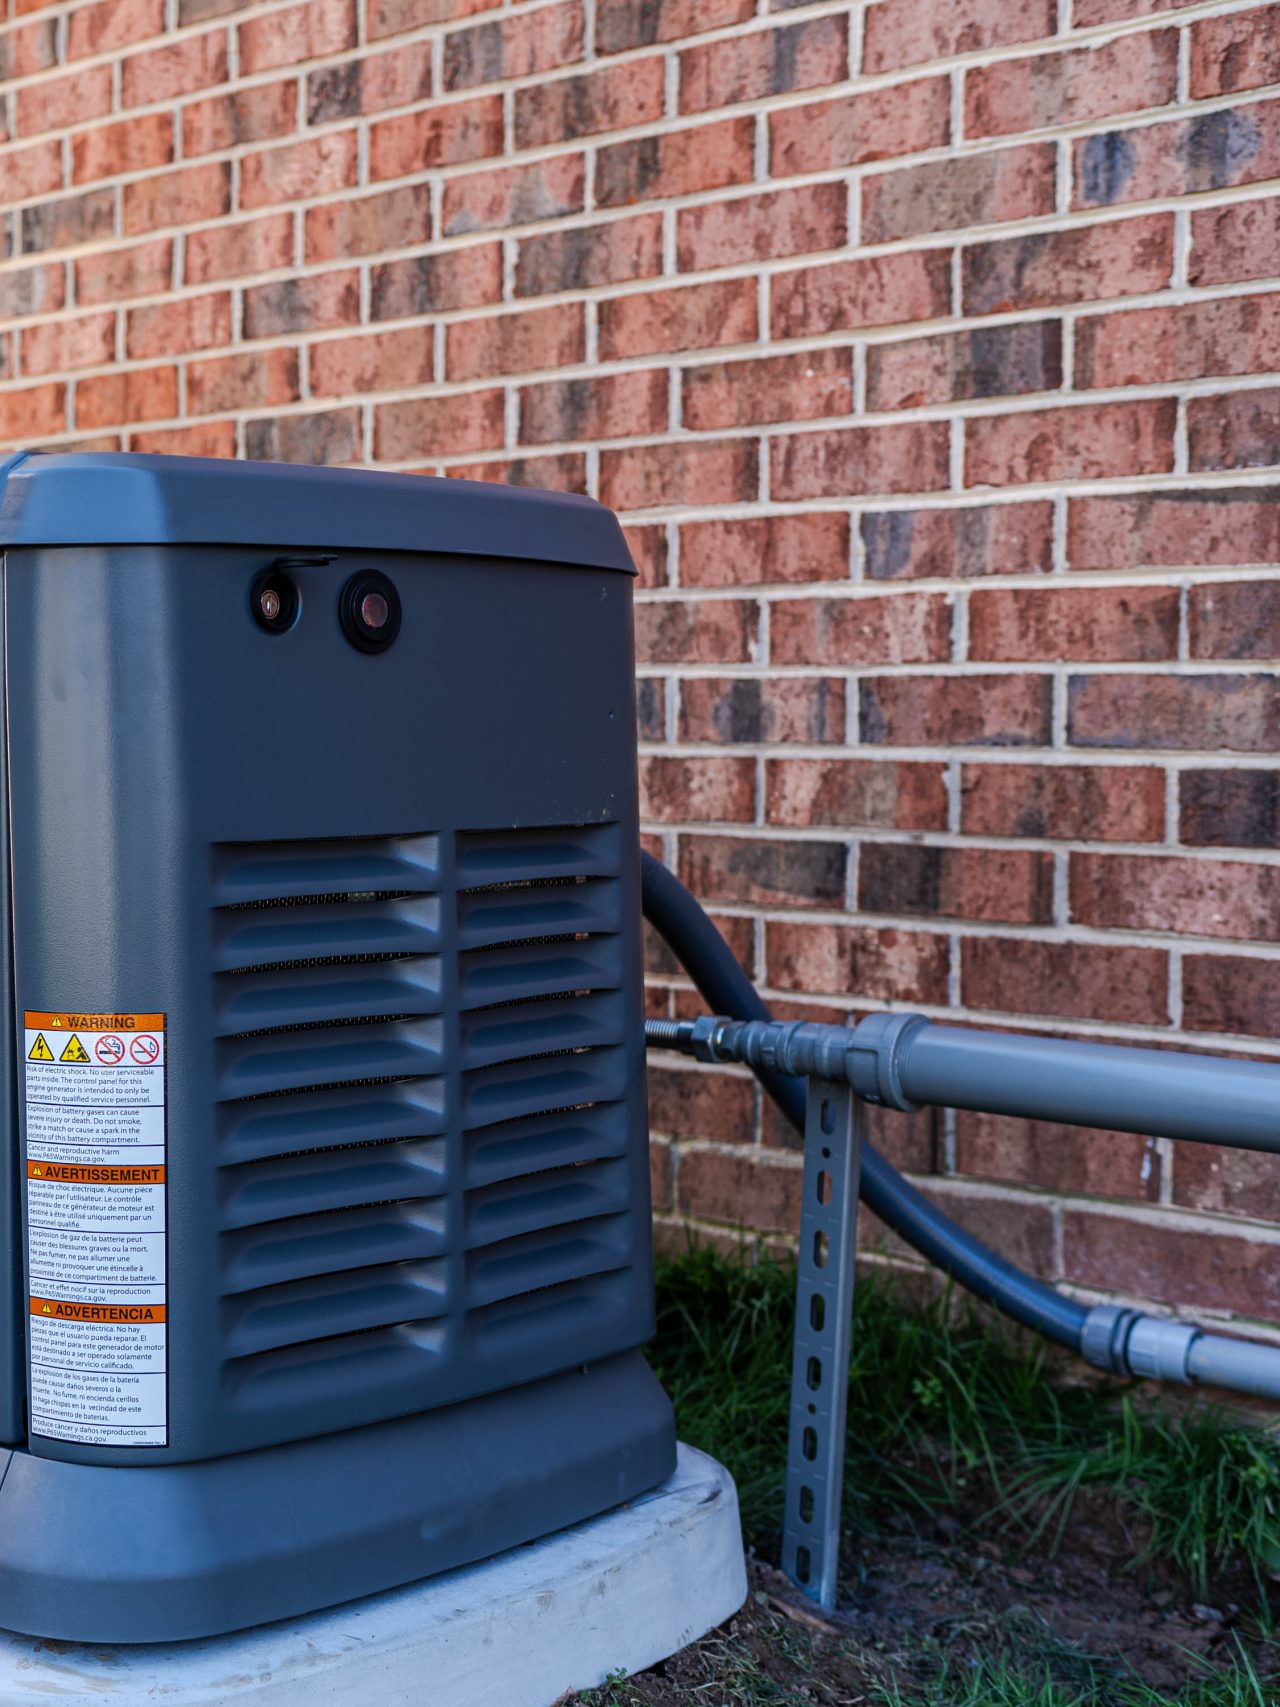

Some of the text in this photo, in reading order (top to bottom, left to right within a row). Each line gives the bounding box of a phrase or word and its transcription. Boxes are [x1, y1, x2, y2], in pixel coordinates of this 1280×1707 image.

[67, 1016, 135, 1028] WARNING
[45, 1066, 66, 1074] electric
[42, 1075, 59, 1083] inside.
[98, 1077, 117, 1086] panel
[124, 1086, 139, 1095] only
[62, 1094, 89, 1103] qualified
[116, 1095, 150, 1104] personnel.
[62, 1107, 85, 1117] battery
[46, 1114, 62, 1124] injury
[118, 1117, 142, 1125] smoke,
[101, 1126, 119, 1135] spark
[67, 1134, 90, 1144] battery
[92, 1136, 140, 1144] compartment.
[60, 1146, 100, 1154] reproductive
[46, 1166, 160, 1180] AVERTISSEMENT
[72, 1185, 105, 1195] électrique.
[134, 1186, 153, 1195] pièce
[67, 1193, 102, 1202] l'utilisateur.
[71, 1203, 106, 1211] générateur
[87, 1213, 128, 1222] uniquement
[57, 1220, 81, 1228] qualifié.
[126, 1236, 142, 1244] peut
[59, 1242, 88, 1251] blessures
[49, 1250, 67, 1260] fumer,
[62, 1263, 95, 1272] provoquer
[72, 1274, 118, 1282] compartiment
[107, 1287, 151, 1296] reproduction
[56, 1304, 154, 1319] ADVERTENCIA
[58, 1321, 84, 1332] descarga
[86, 1324, 114, 1332] eléctrica.
[128, 1325, 140, 1334] hay
[91, 1334, 112, 1342] pueda
[97, 1343, 132, 1351] generador
[43, 1345, 70, 1355] destinado
[88, 1352, 116, 1360] operado
[42, 1355, 65, 1364] personal
[39, 1368, 63, 1377] explosión
[67, 1381, 84, 1389] daños
[62, 1390, 78, 1400] fume,
[86, 1394, 115, 1402] encienda
[51, 1398, 70, 1409] chispas
[84, 1412, 109, 1421] baterías.
[54, 1422, 73, 1431] cáncer
[79, 1425, 99, 1434] daños
[100, 1428, 147, 1436] reproductivos
